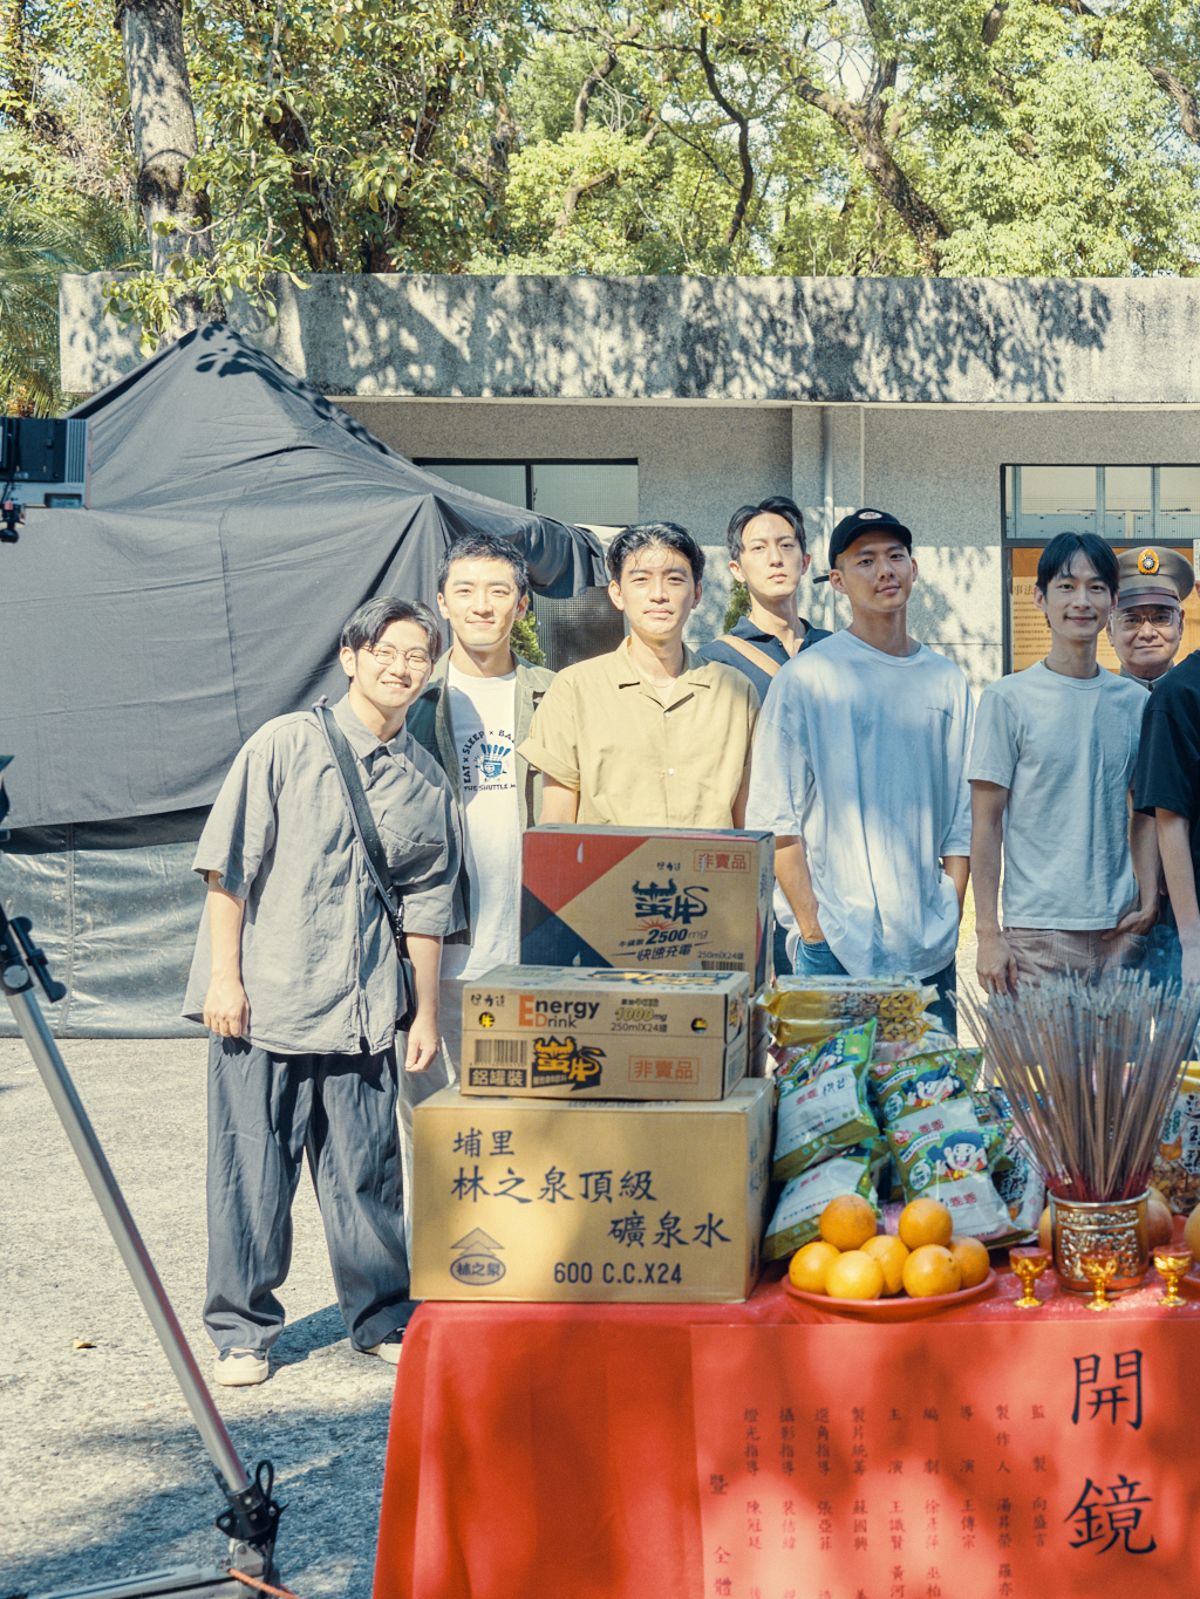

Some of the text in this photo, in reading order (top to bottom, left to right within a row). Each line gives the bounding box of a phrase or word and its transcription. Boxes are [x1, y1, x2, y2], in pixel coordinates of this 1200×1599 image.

[463, 731, 485, 754] SLEEP
[463, 766, 471, 783] EAT
[699, 852, 747, 871] 非賣品
[645, 928, 709, 945] 2500mg
[637, 943, 693, 961] 快速充電
[518, 994, 600, 1028] Energy
[535, 1014, 577, 1029] Drink
[471, 1070, 526, 1086] 鋁罐裝
[634, 1059, 694, 1080] 非賣品
[453, 1128, 515, 1158] 埔里
[451, 1165, 658, 1204] 林之泉頂級
[608, 1209, 732, 1248] 礦泉水
[455, 1262, 501, 1278] 林之泉
[553, 1262, 682, 1285] 600 C.C.X24
[744, 1407, 761, 1477] 燈光指導
[779, 1406, 796, 1477] 攝影指導
[815, 1407, 831, 1477] 選角指導
[852, 1406, 869, 1477] 製片統籌
[995, 1404, 1012, 1474] 製作人
[1063, 1348, 1158, 1556] 開鏡
[961, 1499, 976, 1550] 王傳宗
